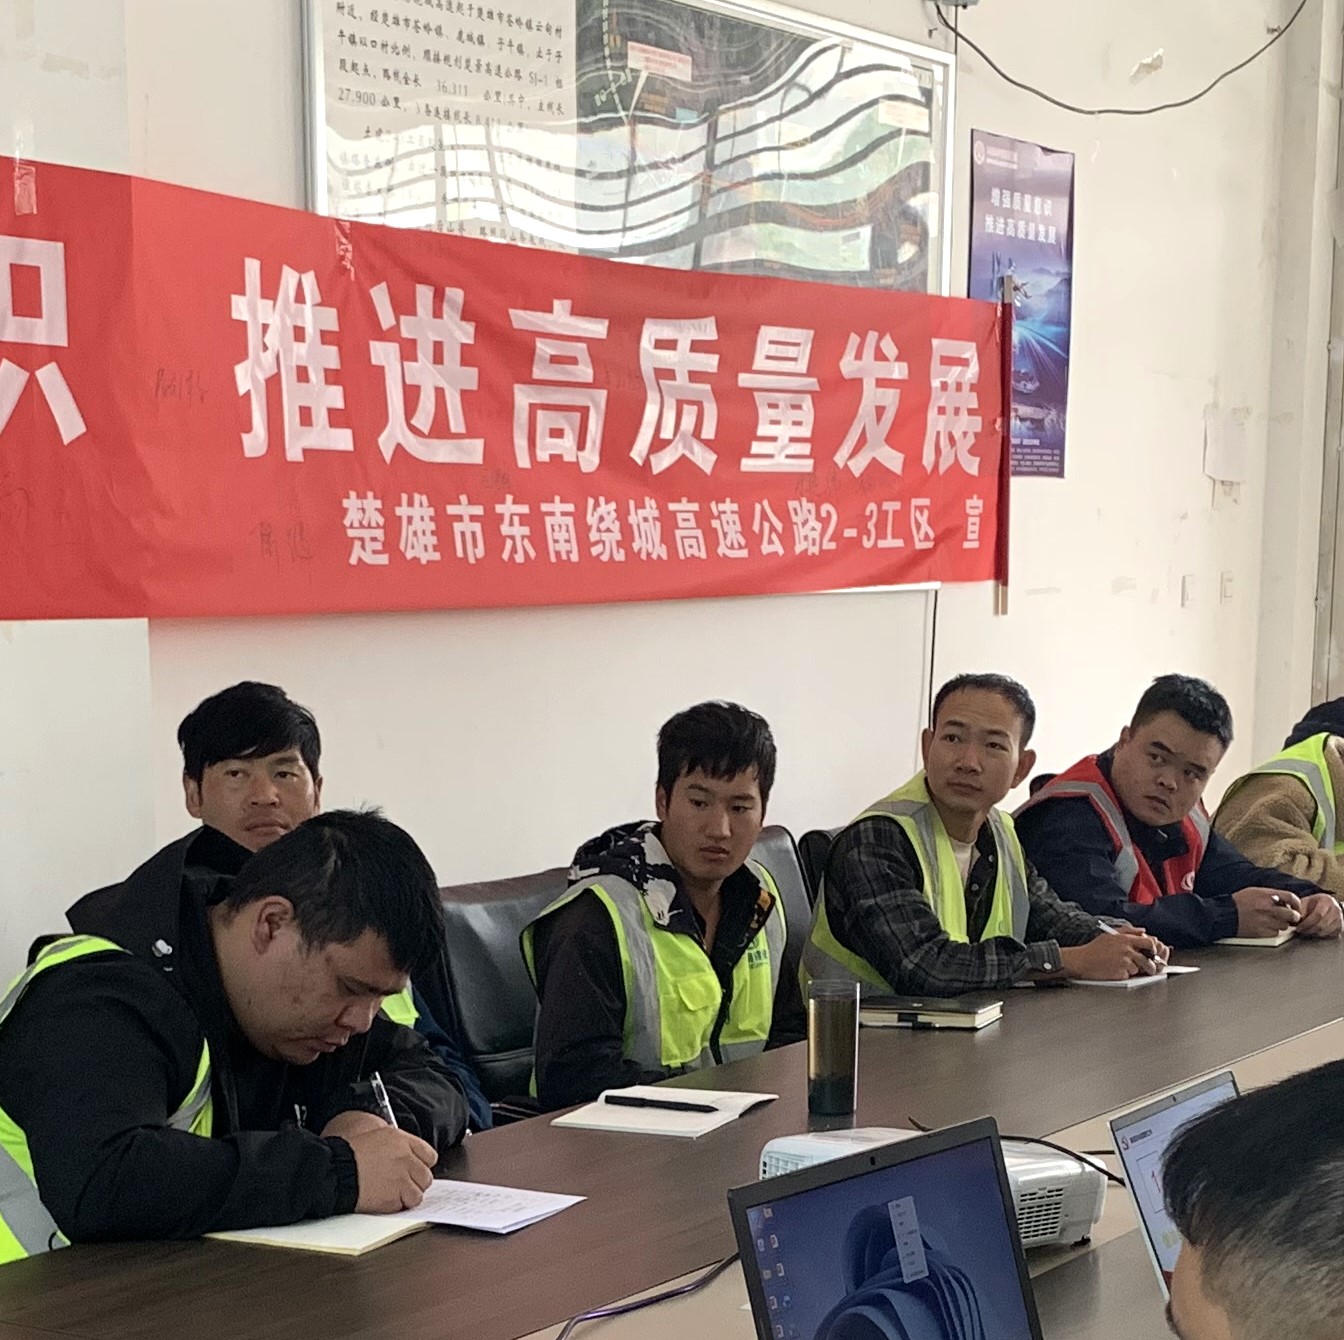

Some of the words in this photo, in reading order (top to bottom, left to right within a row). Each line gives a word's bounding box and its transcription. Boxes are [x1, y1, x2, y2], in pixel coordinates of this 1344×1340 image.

[231, 257, 983, 478] 推进高质量发展
[342, 490, 935, 566] 楚雄市东南绕城高速公路2-3工区
[962, 495, 985, 550] 宣
